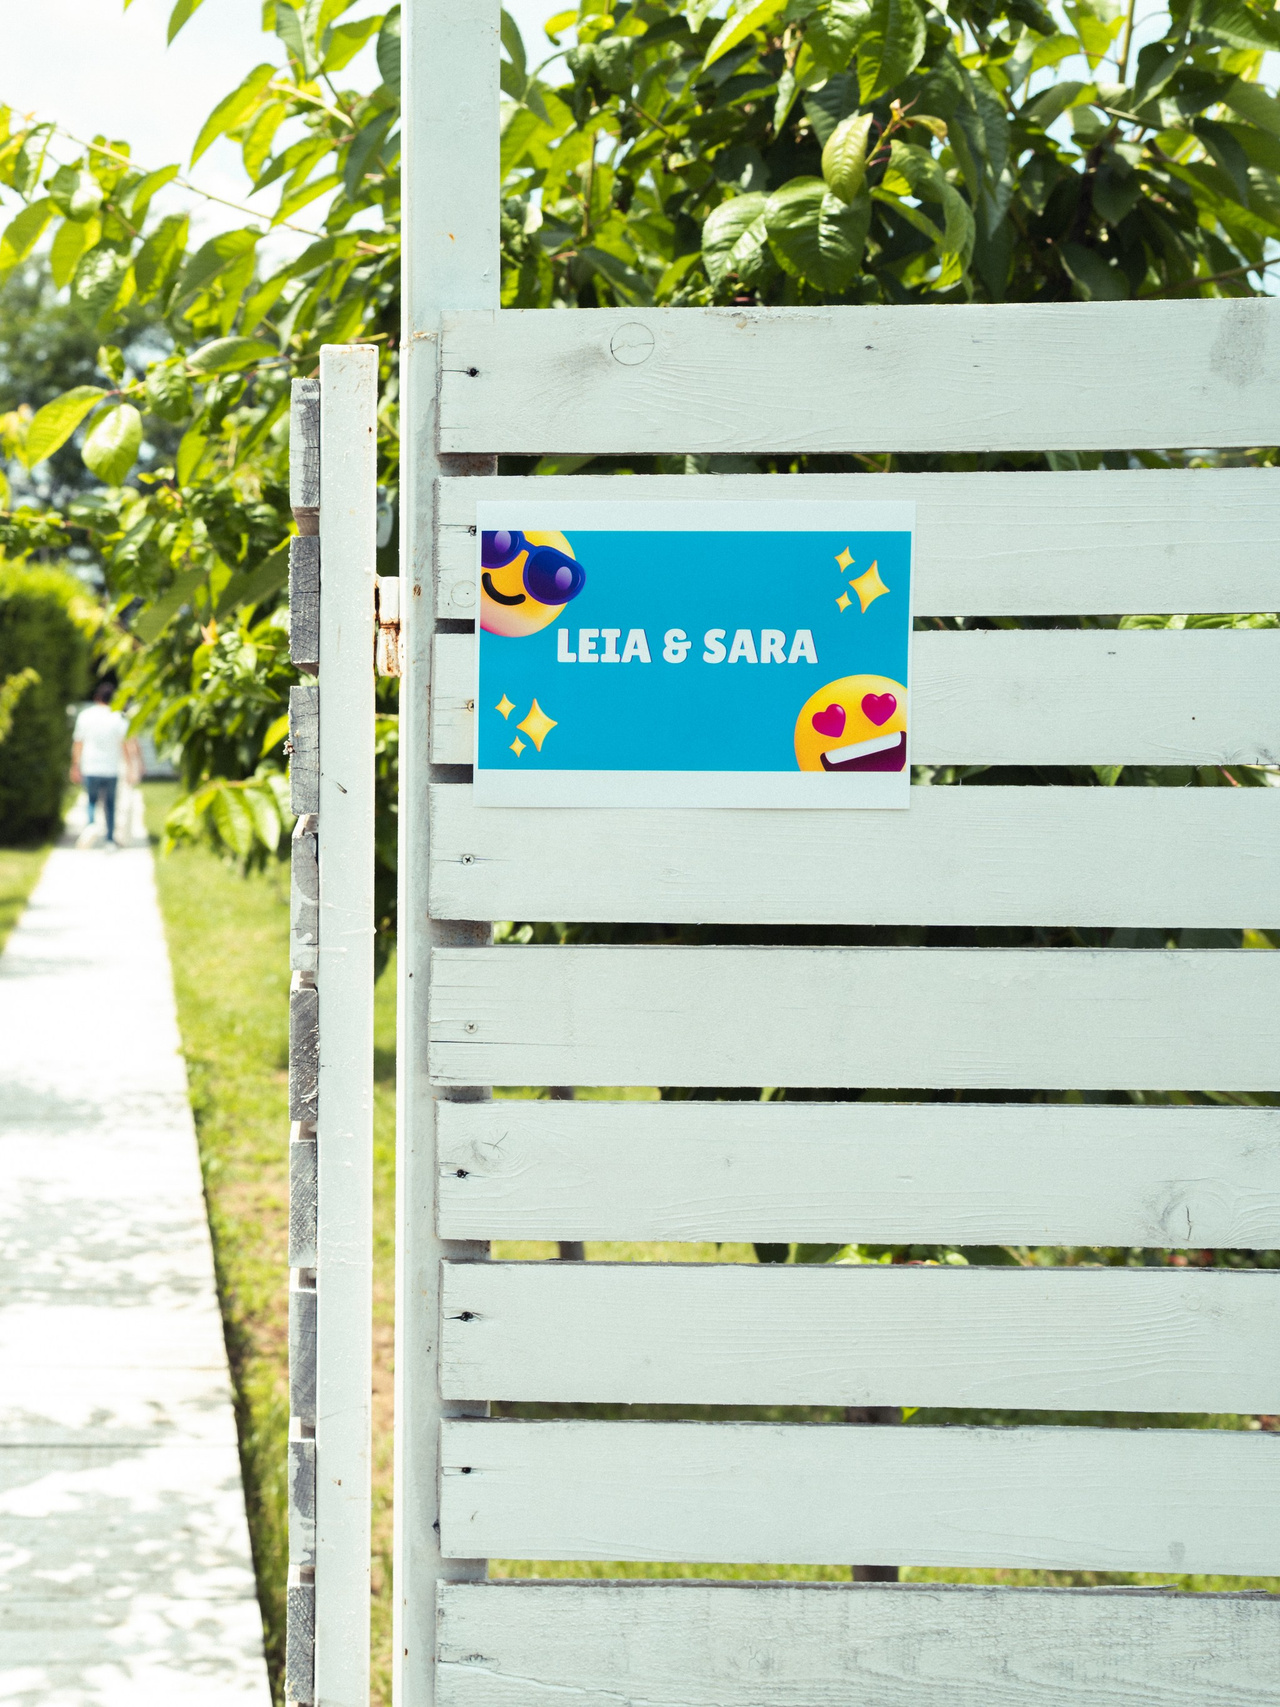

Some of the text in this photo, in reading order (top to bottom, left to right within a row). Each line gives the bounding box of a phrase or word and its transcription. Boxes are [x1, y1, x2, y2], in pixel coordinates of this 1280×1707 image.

[557, 628, 819, 664] LEIA & SARA
